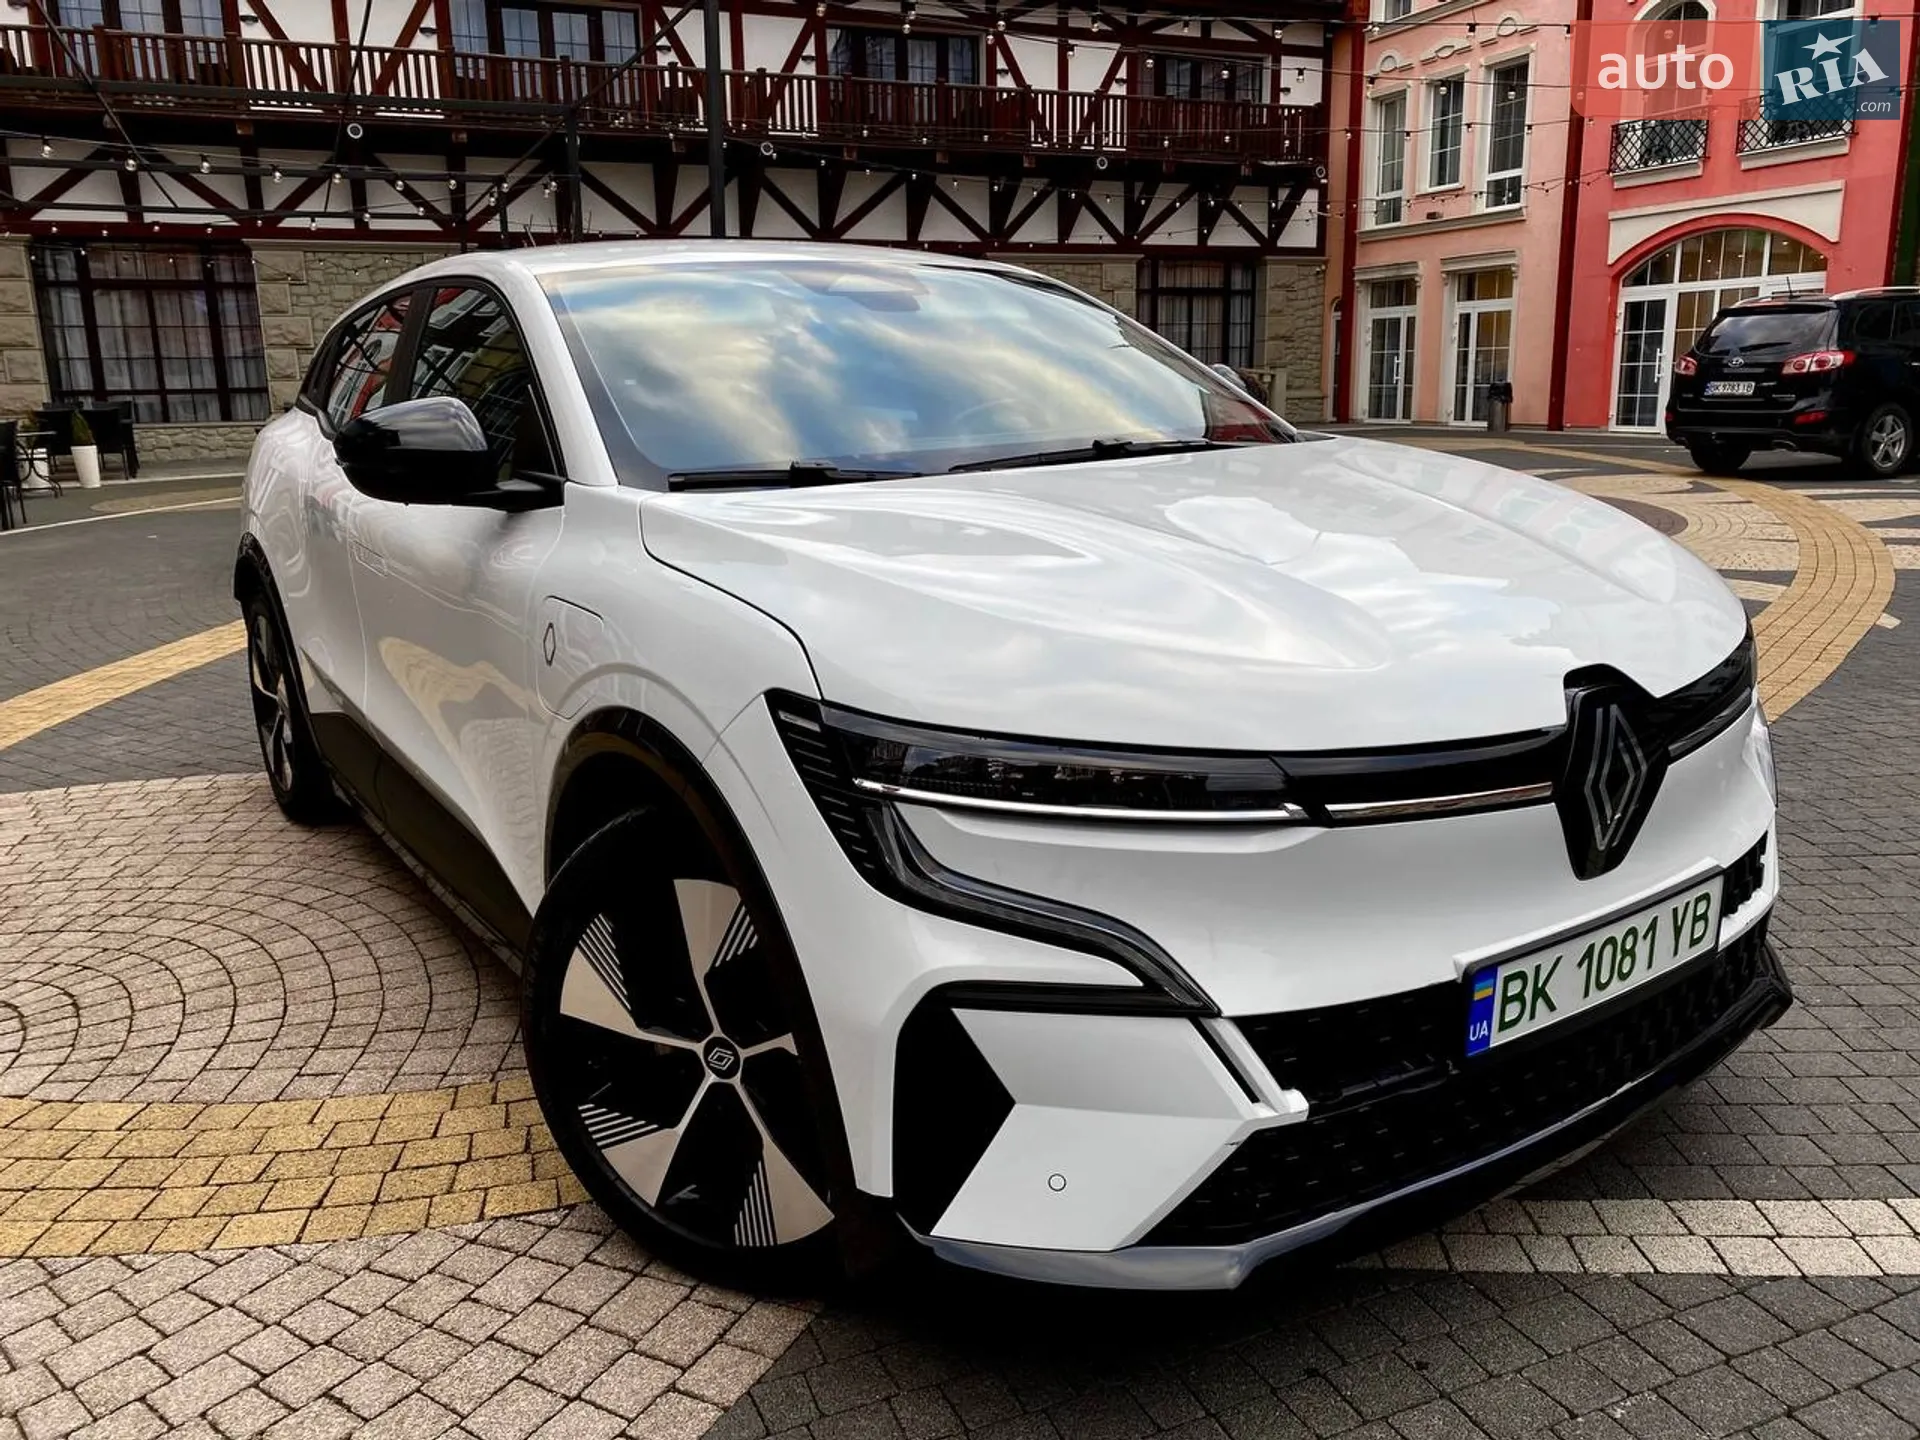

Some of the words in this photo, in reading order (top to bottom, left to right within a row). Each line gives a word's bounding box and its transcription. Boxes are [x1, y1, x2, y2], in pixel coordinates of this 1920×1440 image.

[1498, 955, 1563, 1033] BK
[1577, 915, 1659, 999] 1081
[1672, 891, 1712, 958] YB
[1469, 1024, 1489, 1041] UA
